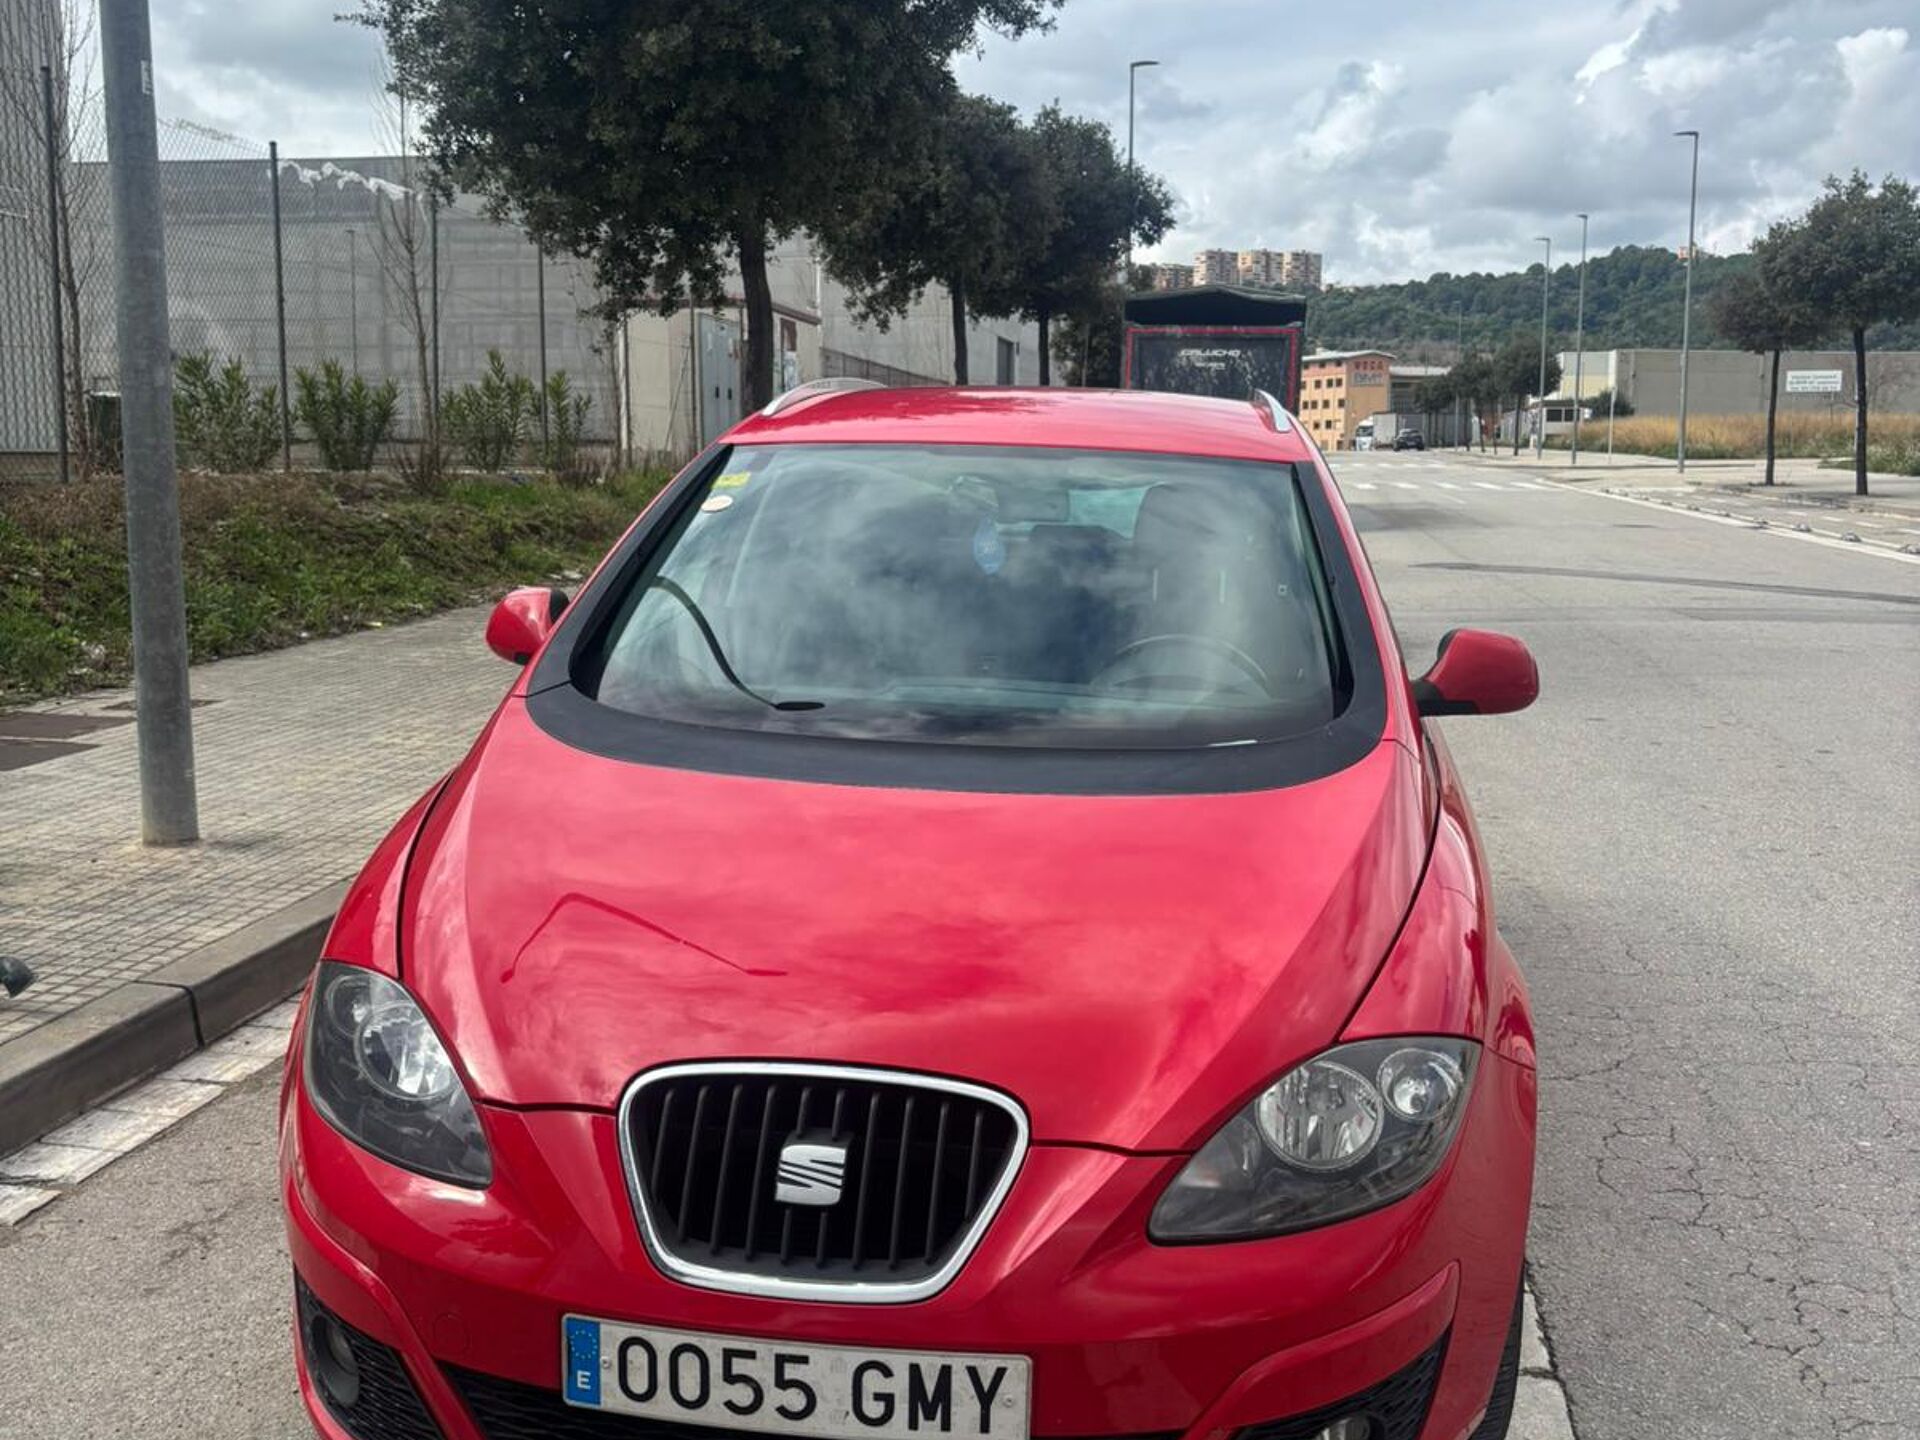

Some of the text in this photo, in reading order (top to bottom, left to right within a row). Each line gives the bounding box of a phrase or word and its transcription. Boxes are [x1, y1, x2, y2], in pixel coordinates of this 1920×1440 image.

[576, 1371, 592, 1390] E
[617, 1336, 1007, 1434] 0055 GMY
